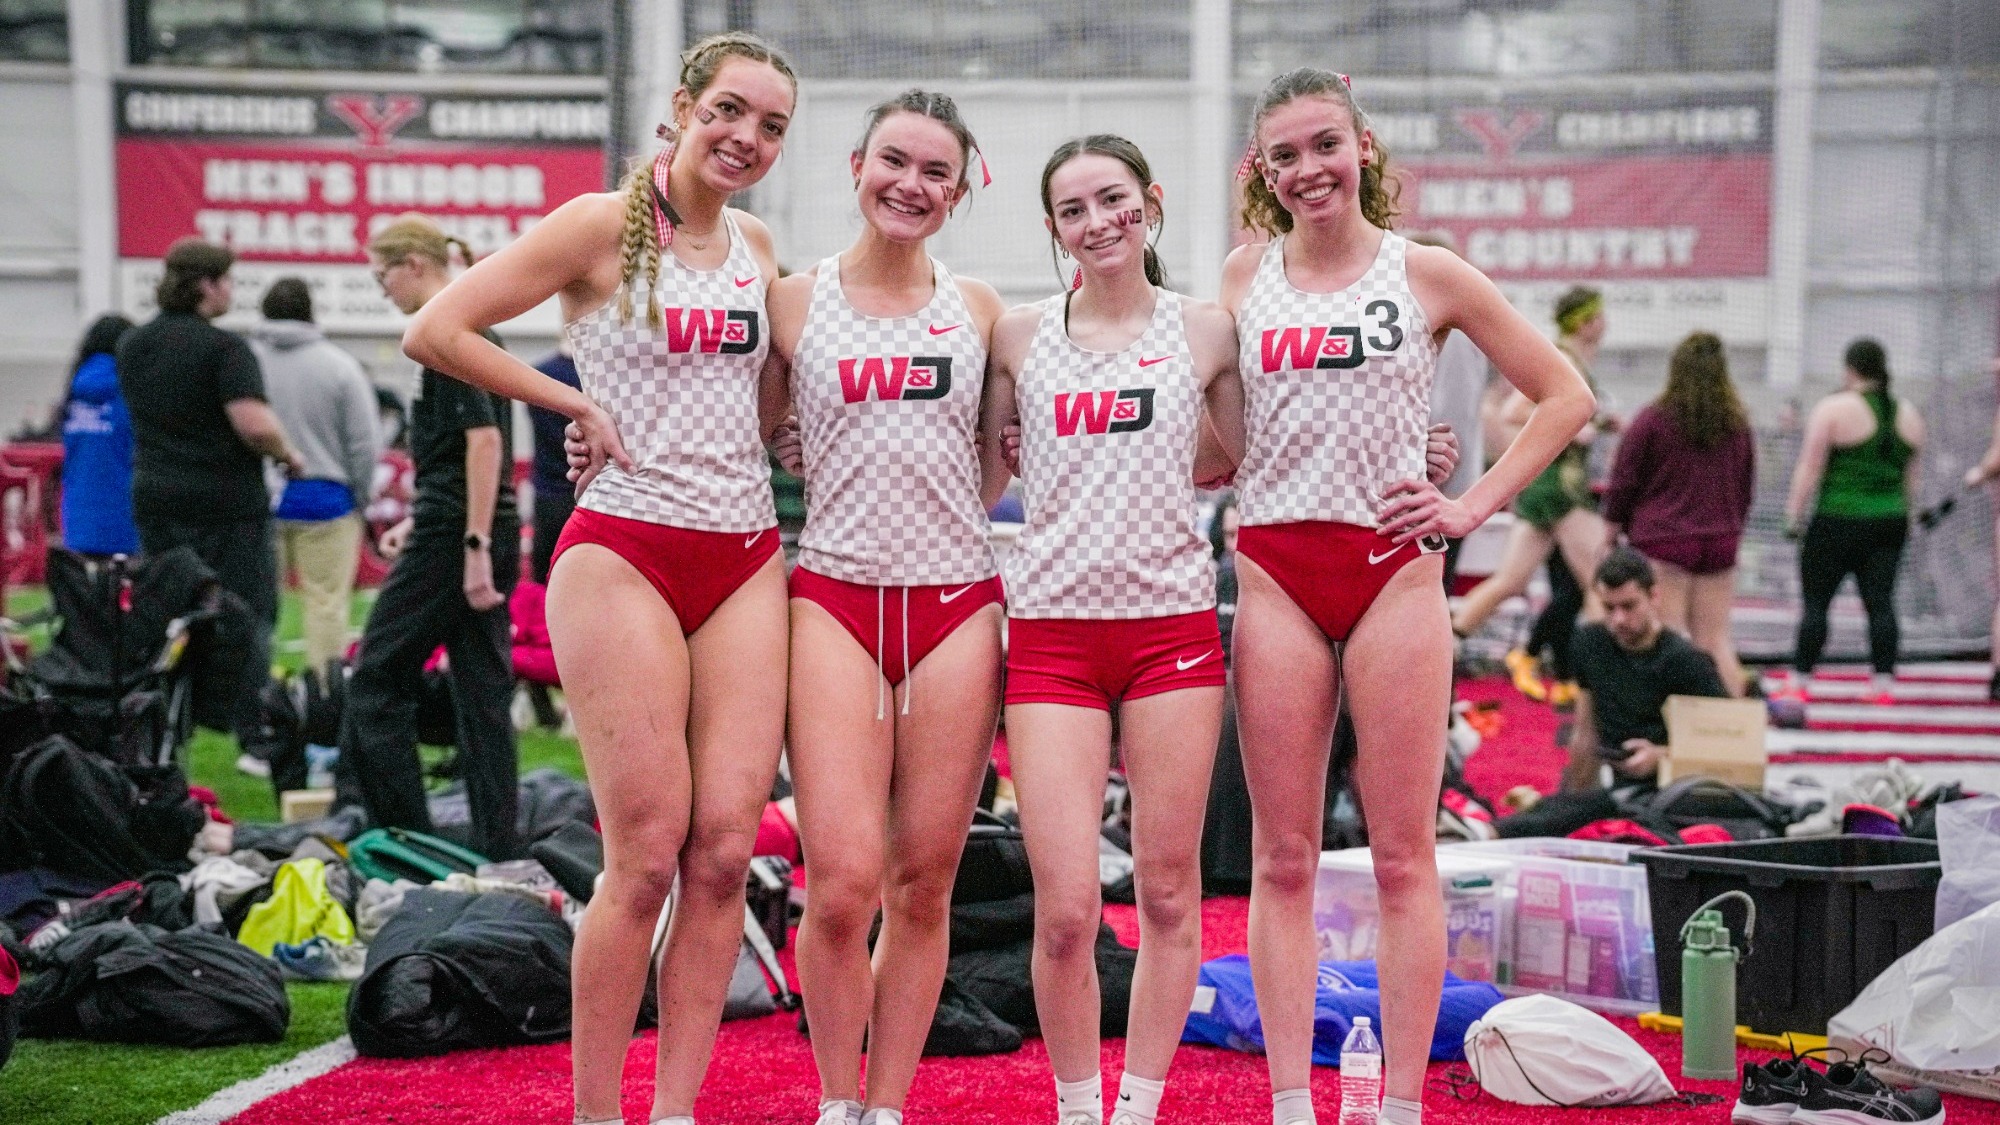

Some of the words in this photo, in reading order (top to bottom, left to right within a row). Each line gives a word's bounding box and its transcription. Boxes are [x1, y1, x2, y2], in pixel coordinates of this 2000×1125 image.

[126, 92, 316, 134] CONFERENCE
[1556, 106, 1759, 146] CHAMPIONS
[203, 159, 356, 206] MEN'S
[366, 162, 546, 208] INDOOR
[1418, 177, 1573, 220] MEN'S
[1466, 225, 1700, 270] COUNTRY
[665, 308, 760, 355] W&J
[1365, 300, 1403, 352] 3
[1260, 326, 1367, 374] W&J
[837, 356, 953, 404] W&J
[1054, 388, 1156, 438] W&J
